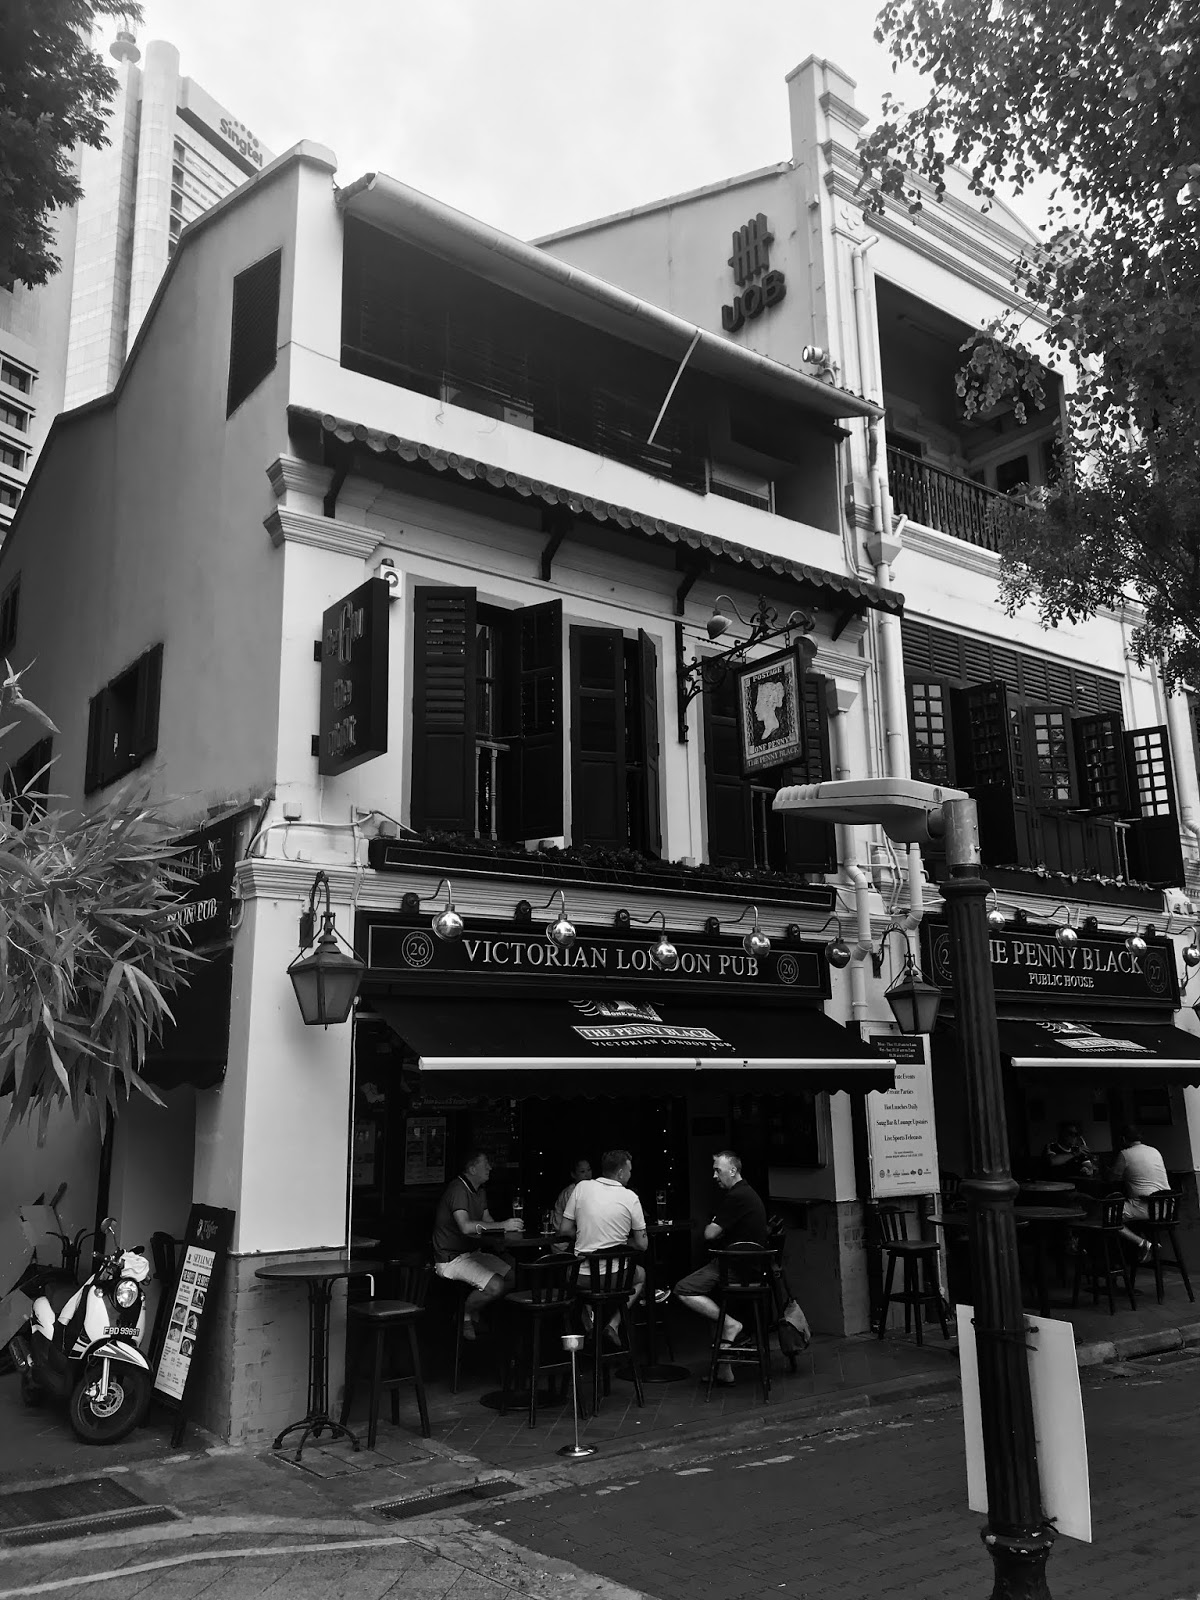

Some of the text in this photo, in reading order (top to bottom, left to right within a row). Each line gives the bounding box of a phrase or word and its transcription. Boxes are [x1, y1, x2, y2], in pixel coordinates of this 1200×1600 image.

[219, 118, 262, 167] Singtel
[721, 270, 787, 333] UOB
[753, 665, 783, 682] POSTAGE
[754, 736, 790, 753] ONE PENNY
[759, 752, 779, 764] PENNY
[779, 746, 799, 757] BLACK
[410, 942, 426, 956] 26
[942, 948, 950, 965] 2
[462, 939, 608, 969] VICTORIAN
[718, 954, 759, 976] PUB
[1011, 941, 1080, 970] PENNY
[1082, 947, 1144, 974] BLACK
[783, 963, 794, 974] 26
[1150, 965, 1160, 980] 27
[1028, 972, 1095, 988] PUBLIC HOUSE
[580, 1026, 714, 1038] THE PENNY BLACK
[591, 1039, 658, 1047] VICTORIAN
[908, 1103, 918, 1111] Daily
[912, 1118, 928, 1126] Upstairs
